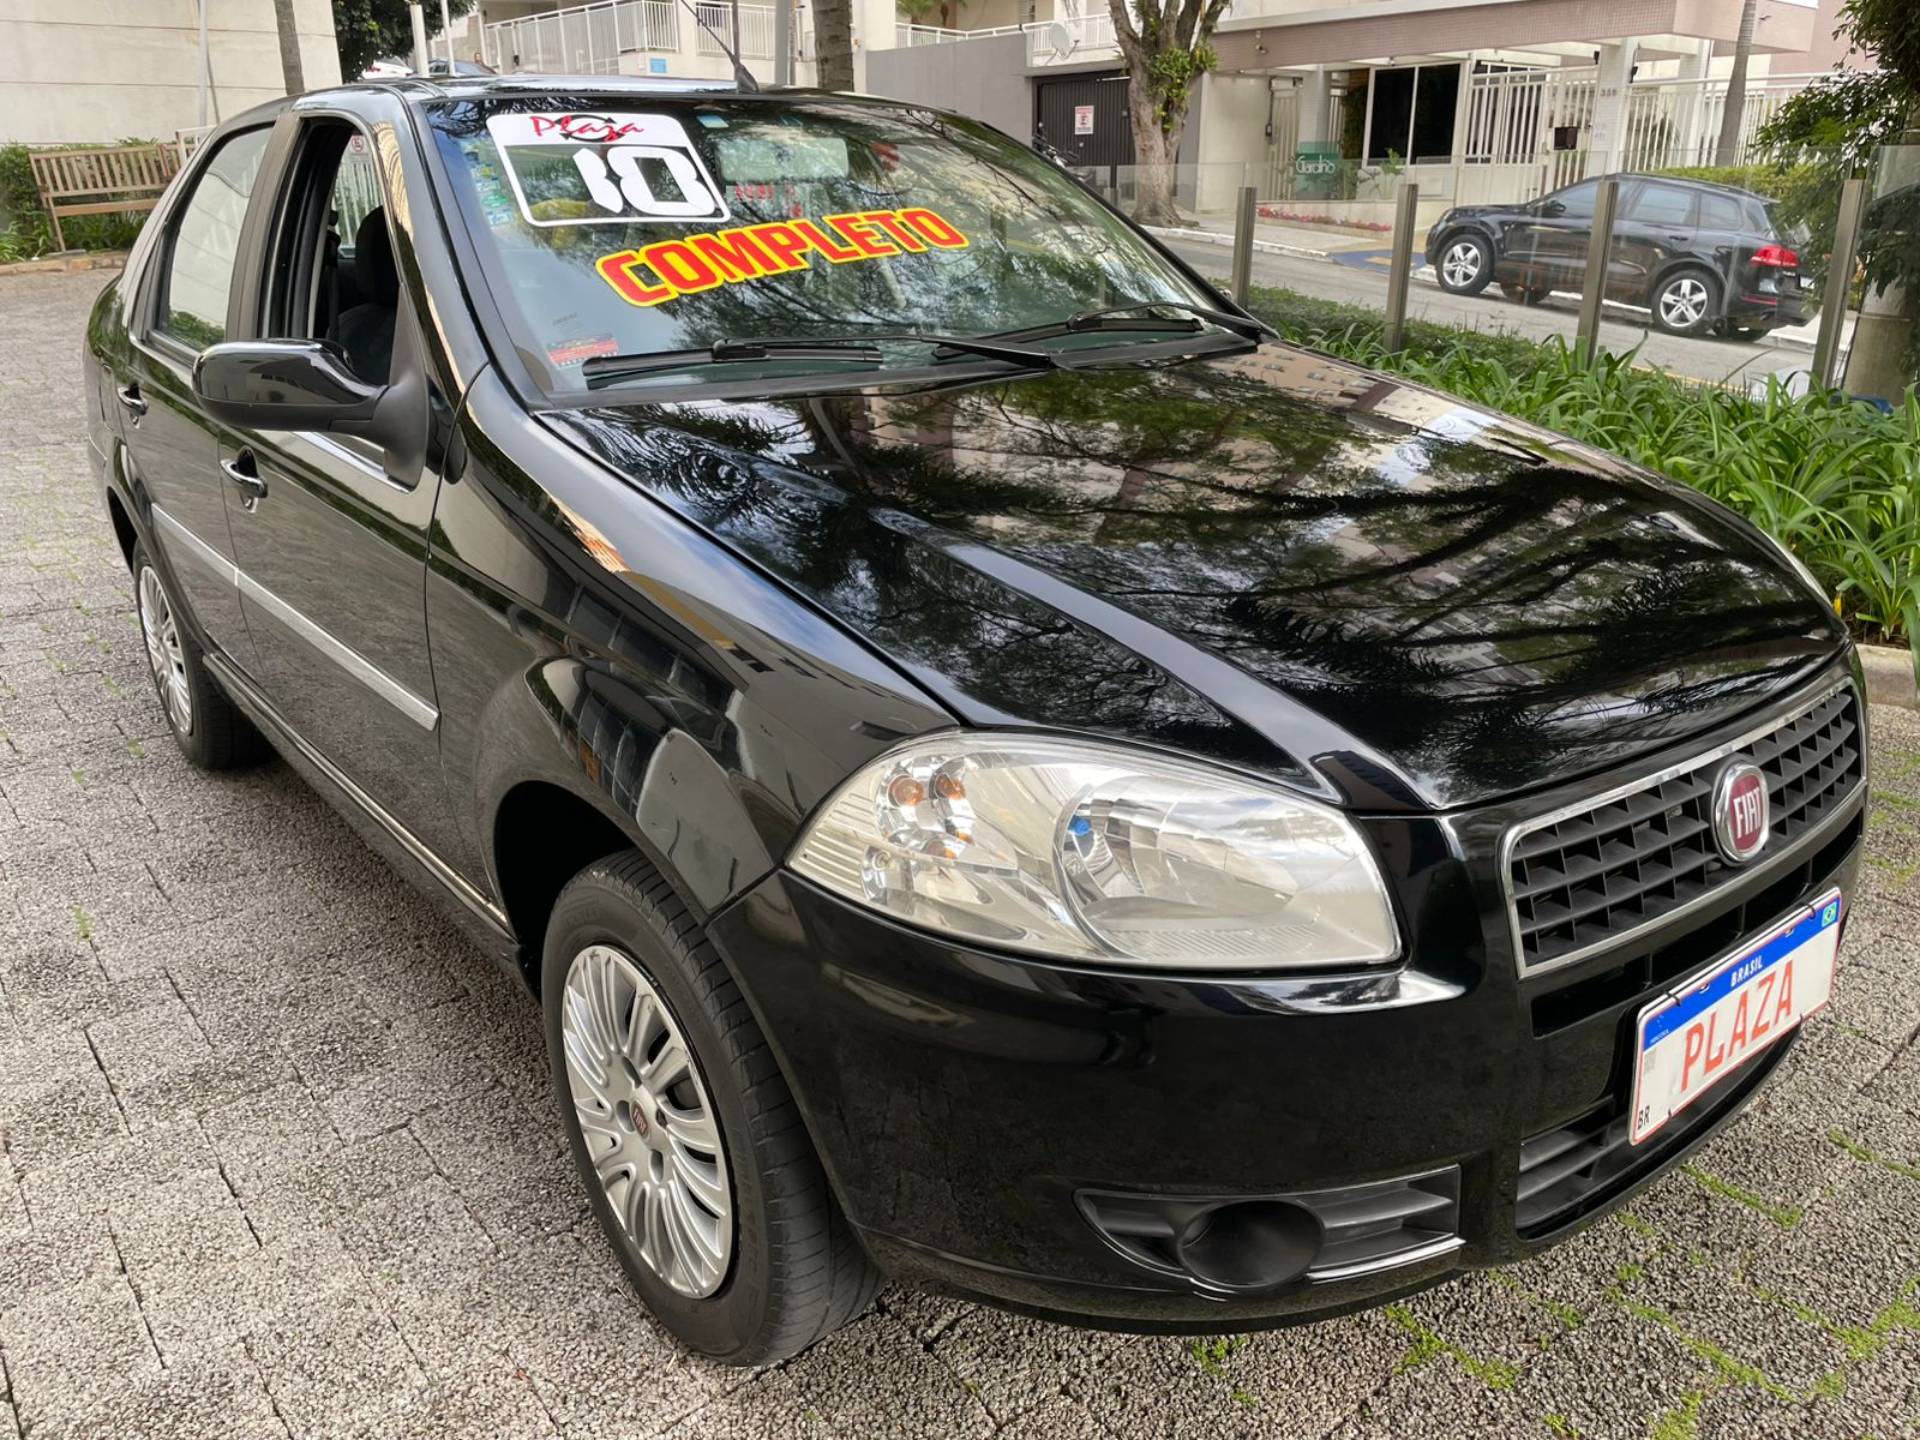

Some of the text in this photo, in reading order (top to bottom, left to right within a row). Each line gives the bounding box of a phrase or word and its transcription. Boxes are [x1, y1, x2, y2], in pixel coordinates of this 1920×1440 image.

[530, 115, 644, 142] Plaza
[596, 207, 969, 307] COMPLETO
[1733, 786, 1760, 839] FIAT
[1730, 954, 1763, 988] BRASIL
[1681, 959, 1793, 1092] PLAZA
[1637, 1104, 1650, 1130] BR
